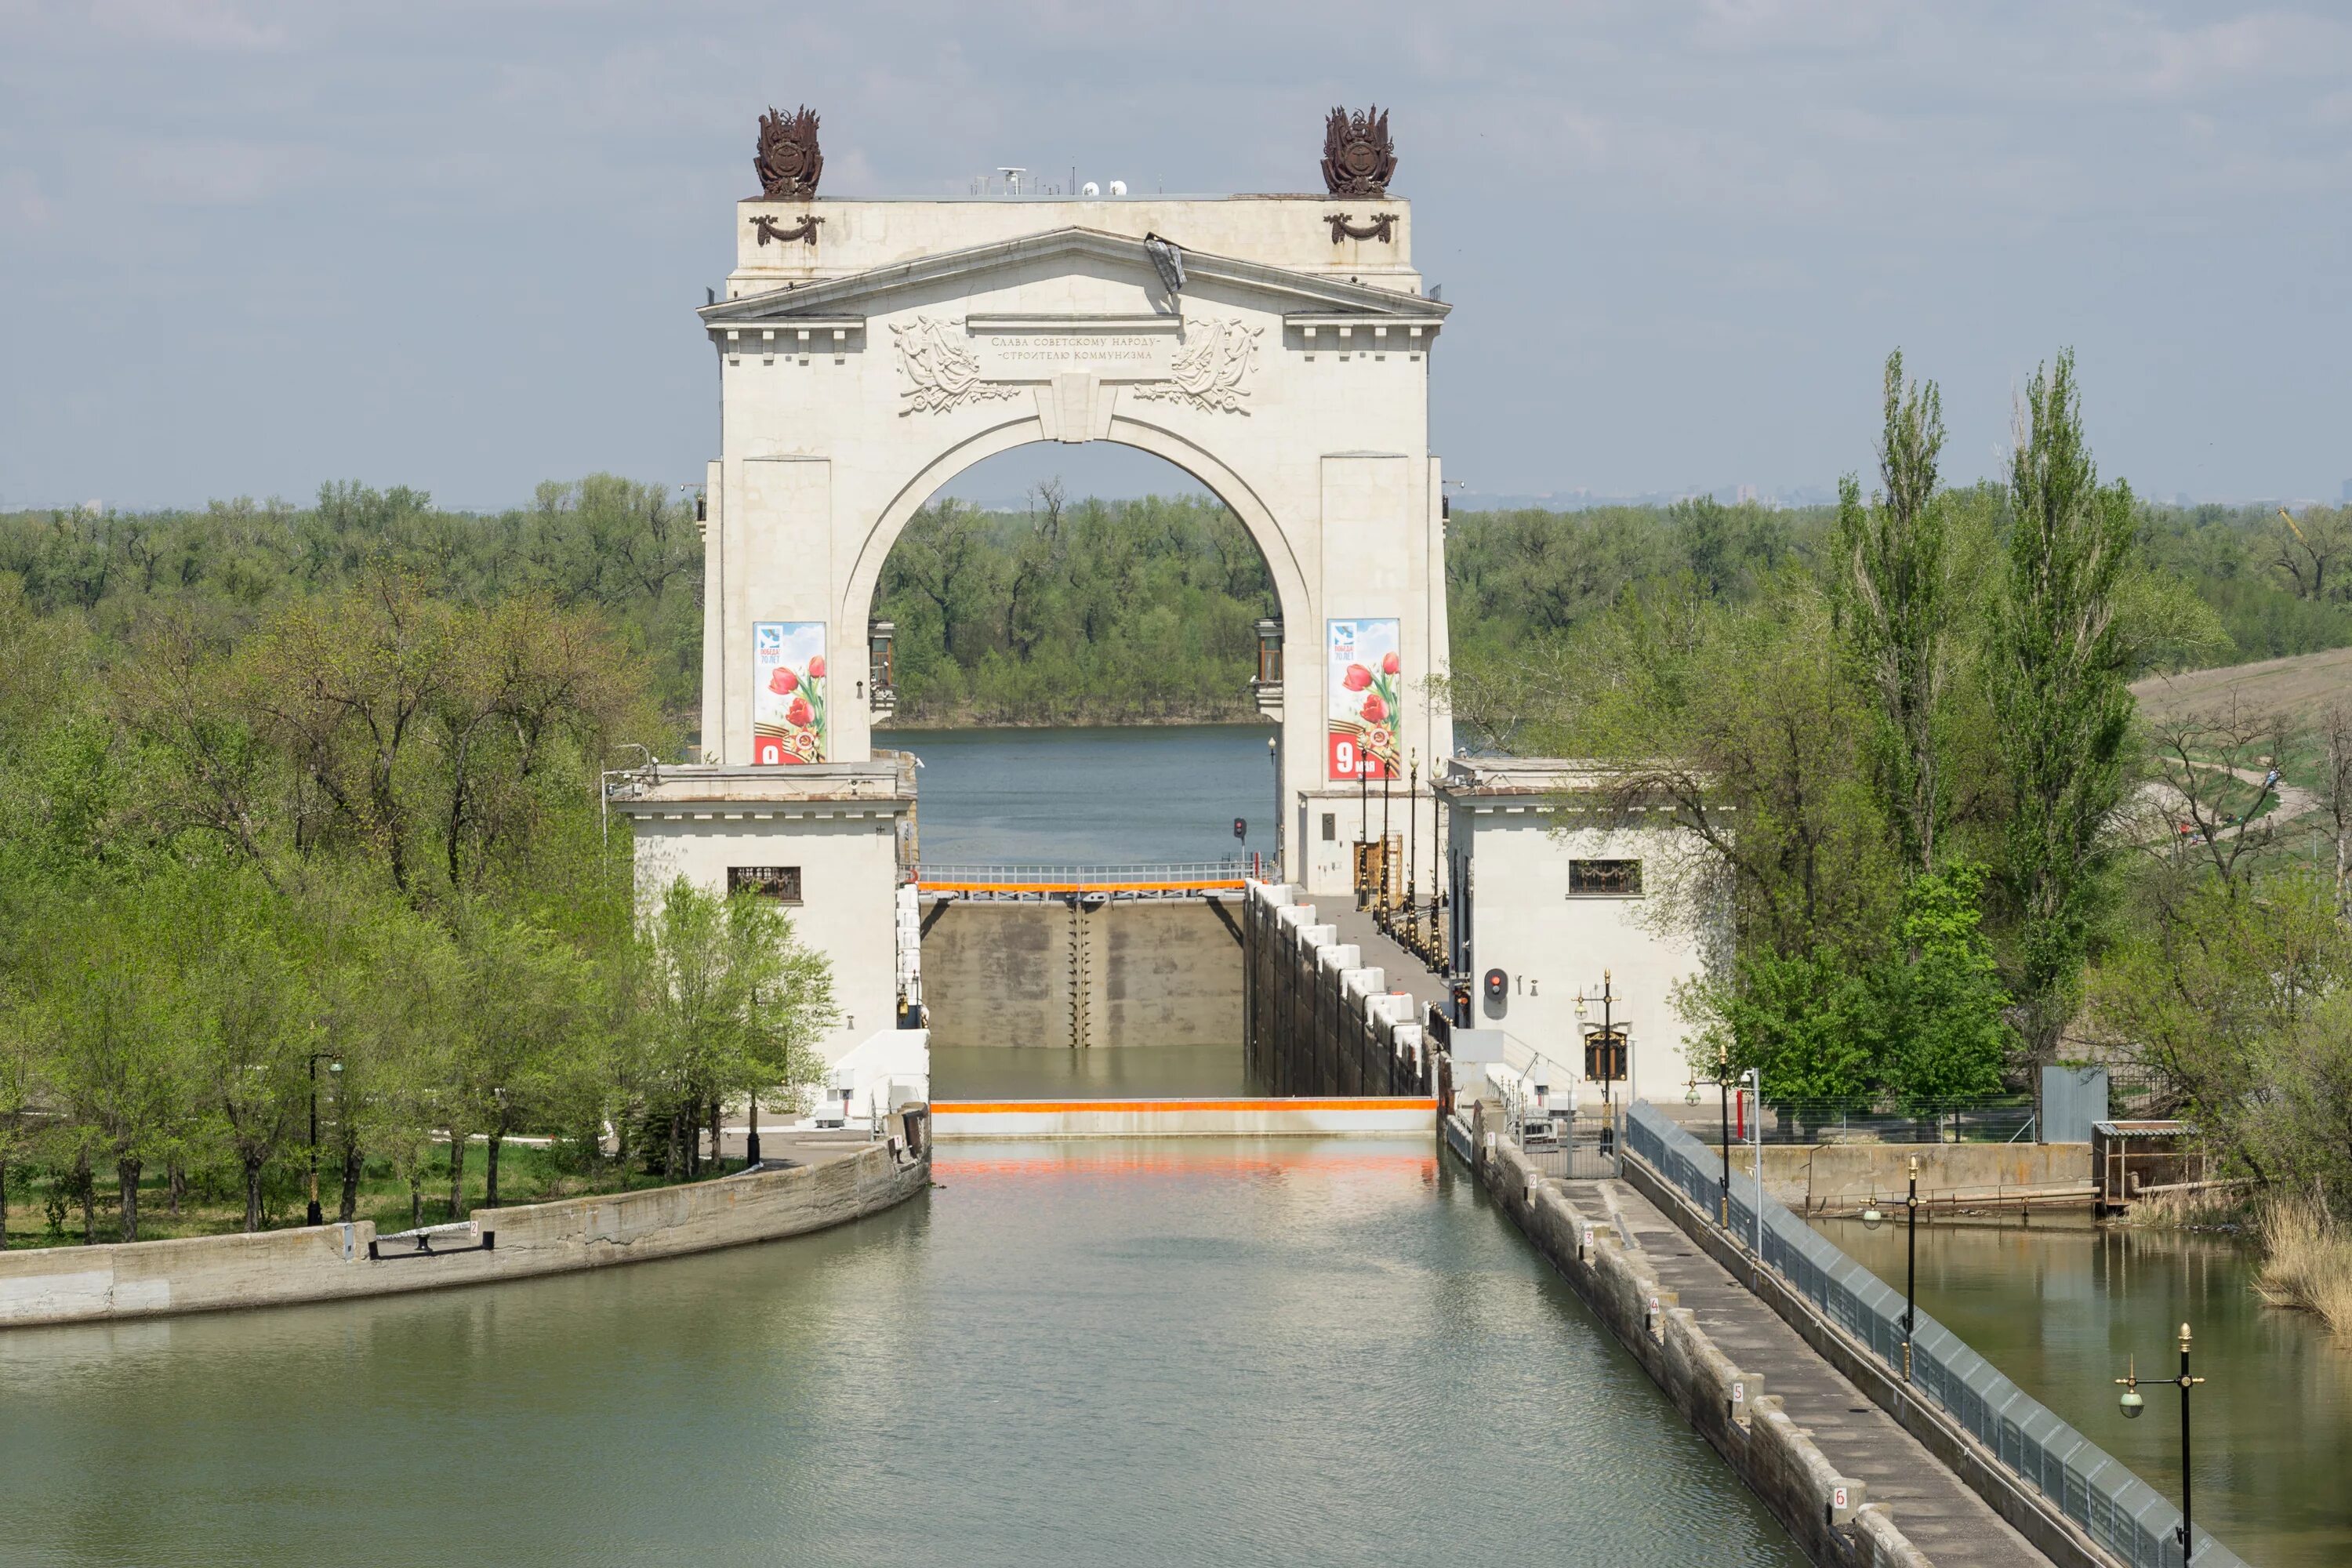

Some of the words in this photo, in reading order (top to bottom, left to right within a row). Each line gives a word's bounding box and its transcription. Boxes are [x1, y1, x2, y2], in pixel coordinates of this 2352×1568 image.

[991, 337, 1028, 347] СЛАВА
[1034, 338, 1107, 347] СОВЕТСКОМУ
[1112, 338, 1161, 347] НАРОДУ-
[998, 351, 1070, 360] -СТРОИТЕЛЮ
[1074, 350, 1152, 360] КОММУНИЗМА
[1337, 742, 1353, 773] 9
[1530, 1175, 1536, 1186] 2
[471, 1222, 477, 1234] 2
[1586, 1233, 1592, 1244] 3
[1651, 1299, 1658, 1312] 4
[1734, 1385, 1741, 1399] 5
[1836, 1490, 1845, 1504] 6
